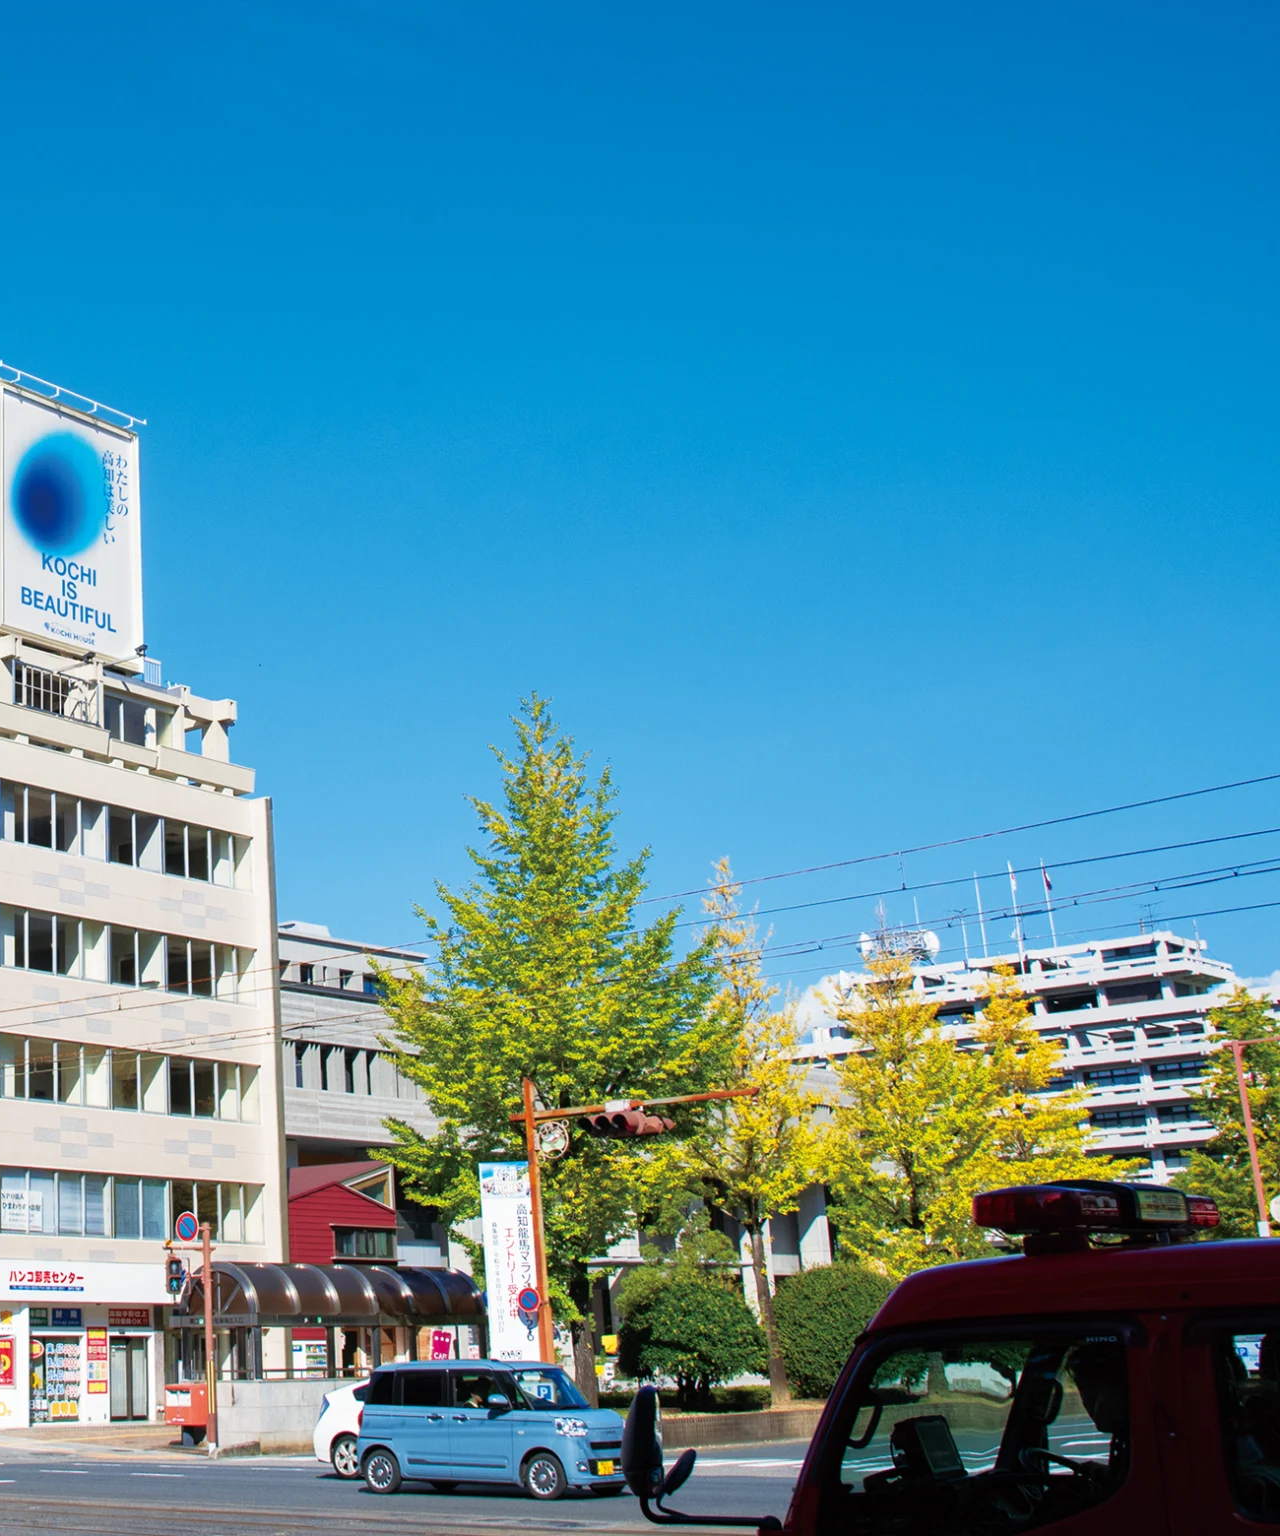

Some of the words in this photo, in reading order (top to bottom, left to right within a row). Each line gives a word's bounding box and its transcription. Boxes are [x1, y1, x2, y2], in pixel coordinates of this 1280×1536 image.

[102, 450, 115, 545] 高知は美しい
[115, 455, 128, 516] わたしの
[41, 552, 97, 587] KOCHI
[61, 579, 78, 600] IS
[21, 586, 117, 633] BEAUTIFUL
[50, 627, 72, 639] KOCHI
[73, 634, 96, 646] HOUSE
[9, 1270, 84, 1284] ハンコ卸売センター
[504, 1228, 521, 1320] エントリー受付中
